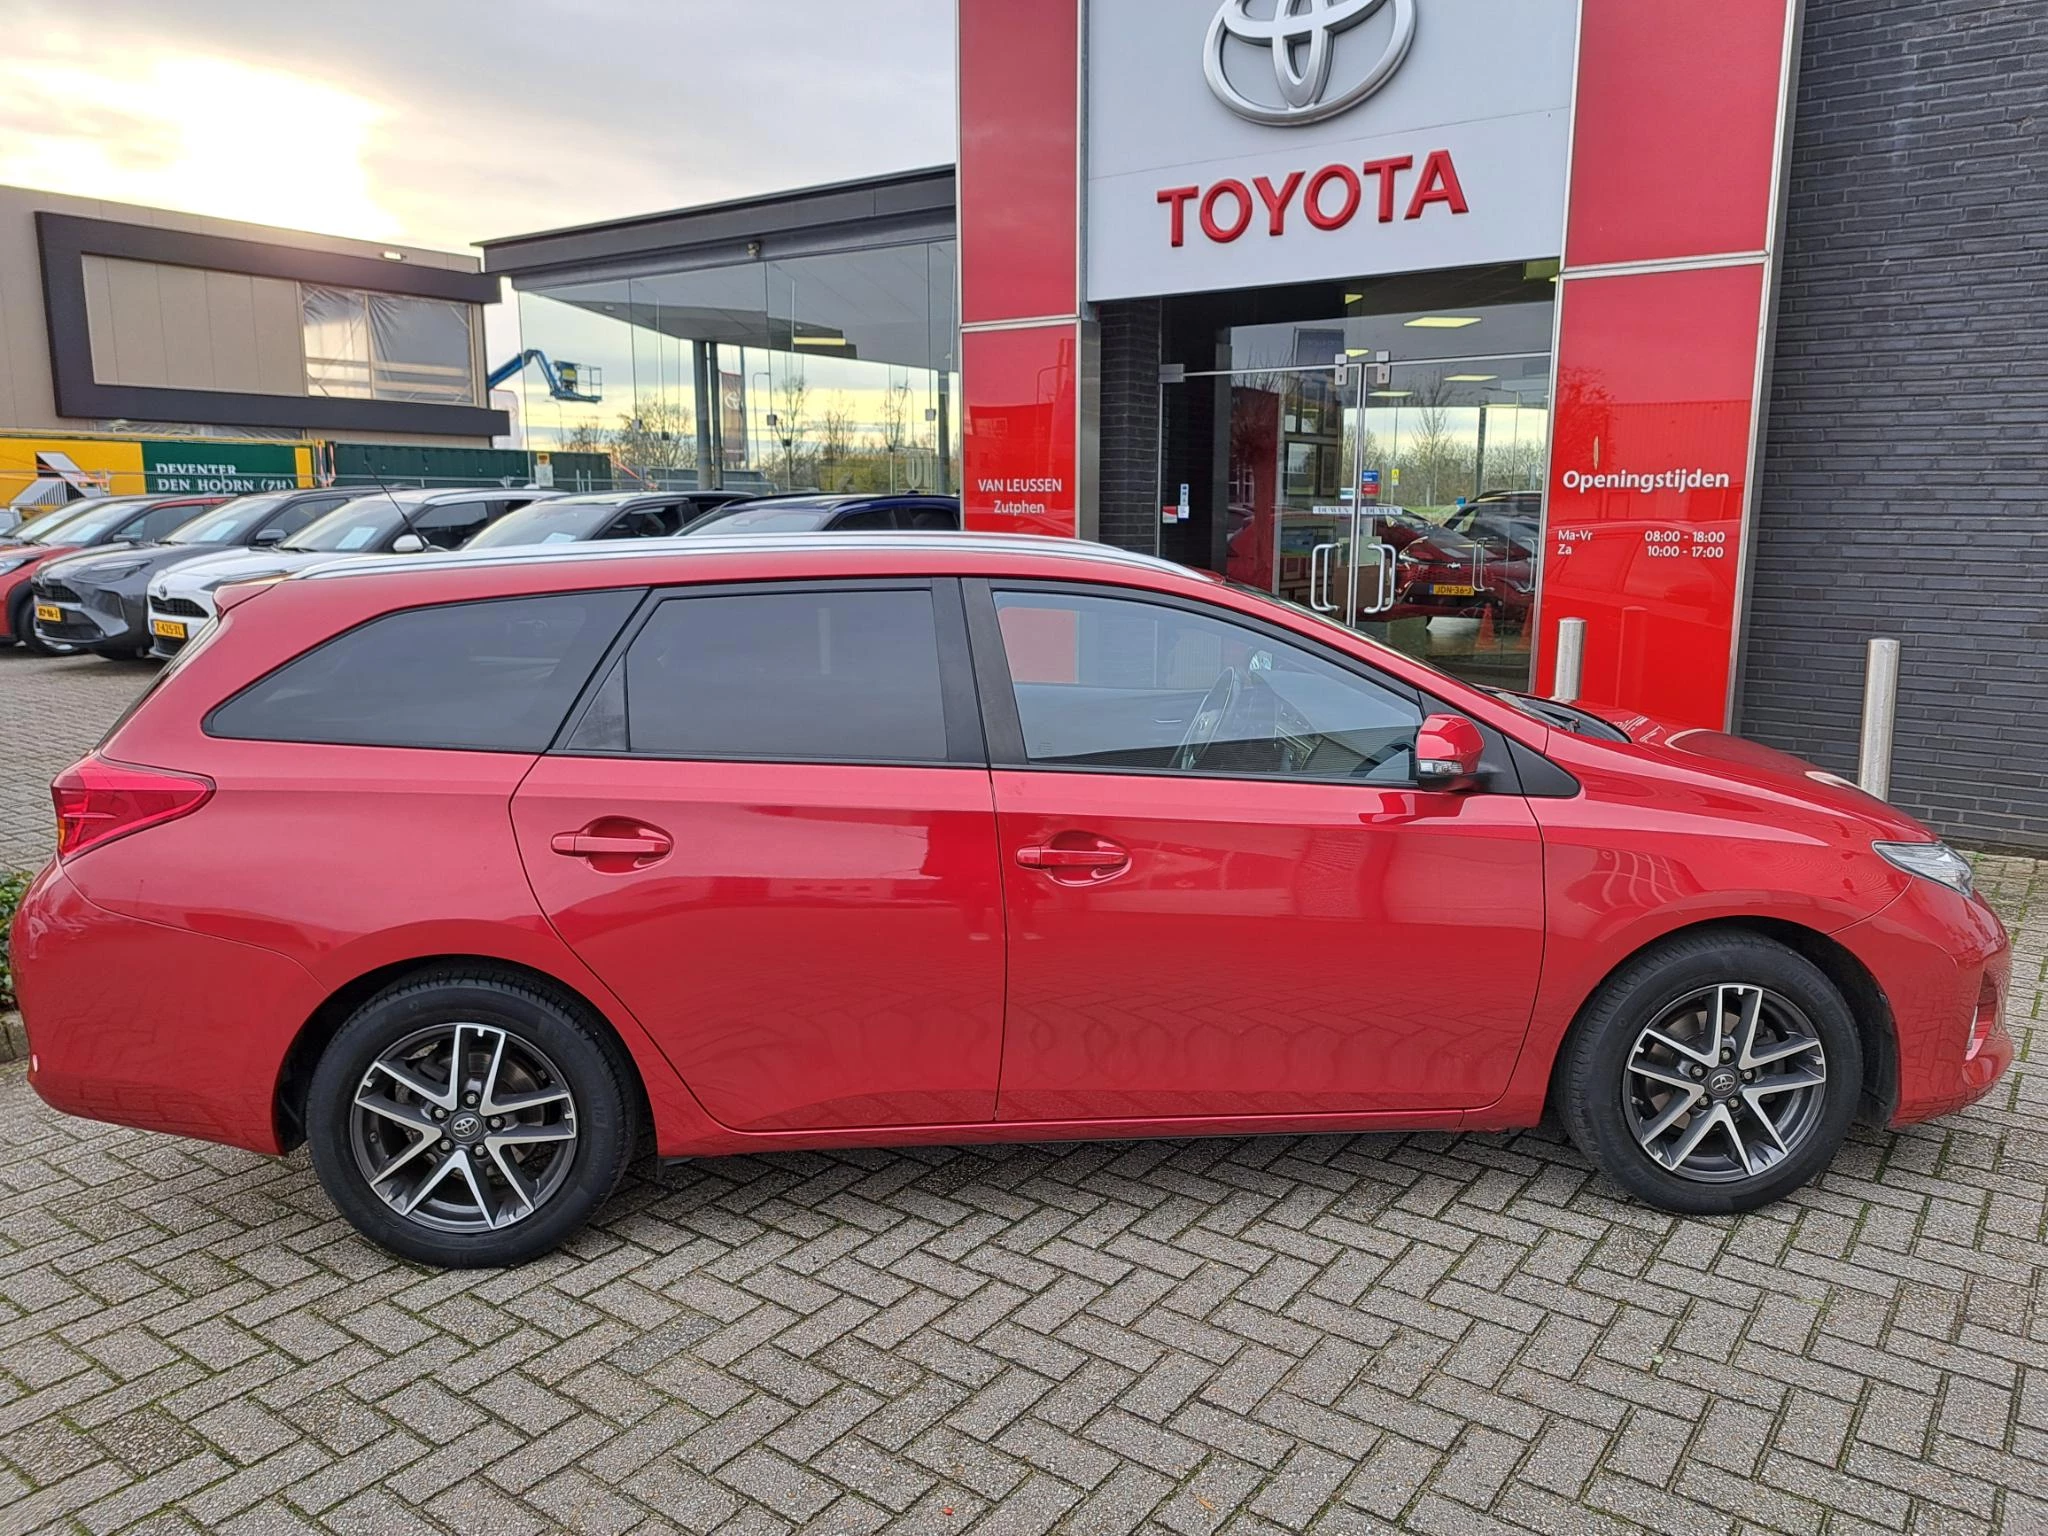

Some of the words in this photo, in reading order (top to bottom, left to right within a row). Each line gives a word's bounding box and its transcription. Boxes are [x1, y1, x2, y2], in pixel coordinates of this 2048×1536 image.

[1157, 150, 1469, 247] TOYOTA
[155, 463, 237, 475] DEVENTER
[158, 479, 191, 491] DEN
[198, 479, 254, 491] HOORN
[978, 479, 1004, 492] VAN
[1007, 478, 1062, 492] LEUSSEN
[1563, 469, 1730, 493] Openingstijden
[994, 500, 1045, 516] Zutphen
[1558, 530, 1592, 541] Ma-Vr
[1645, 531, 1680, 542] 08:00
[1692, 531, 1726, 543] 18:00
[1557, 544, 1572, 555] Za
[1647, 546, 1680, 557] 10:00
[1691, 547, 1724, 558] 17:00
